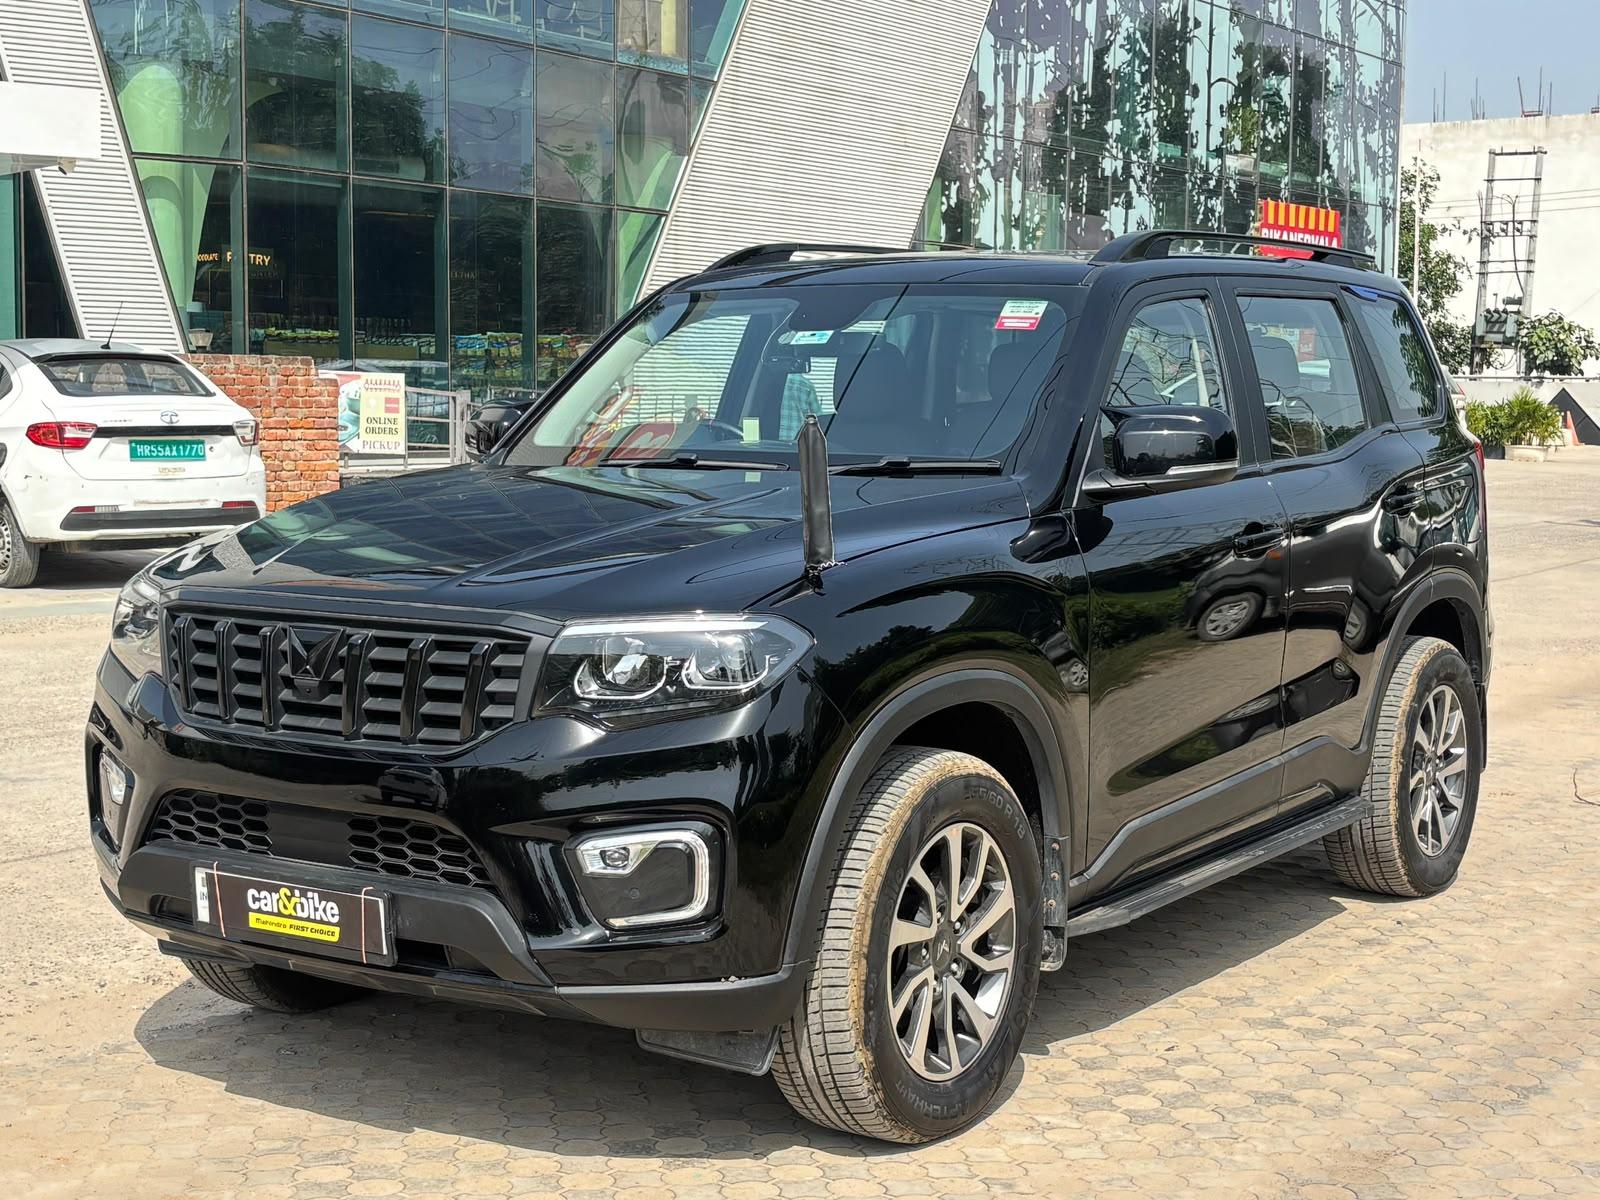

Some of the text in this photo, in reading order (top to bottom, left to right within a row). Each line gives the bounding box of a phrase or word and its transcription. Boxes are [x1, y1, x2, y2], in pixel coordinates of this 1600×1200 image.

[226, 251, 271, 266] PTRY
[366, 416, 399, 426] ONLINE
[365, 426, 399, 436] ORDERS
[136, 443, 205, 457] HR55AX1770
[362, 440, 401, 450] PICKUP
[247, 887, 340, 923] car&bike
[289, 924, 309, 934] FIRST
[309, 927, 337, 937] CHOICE
